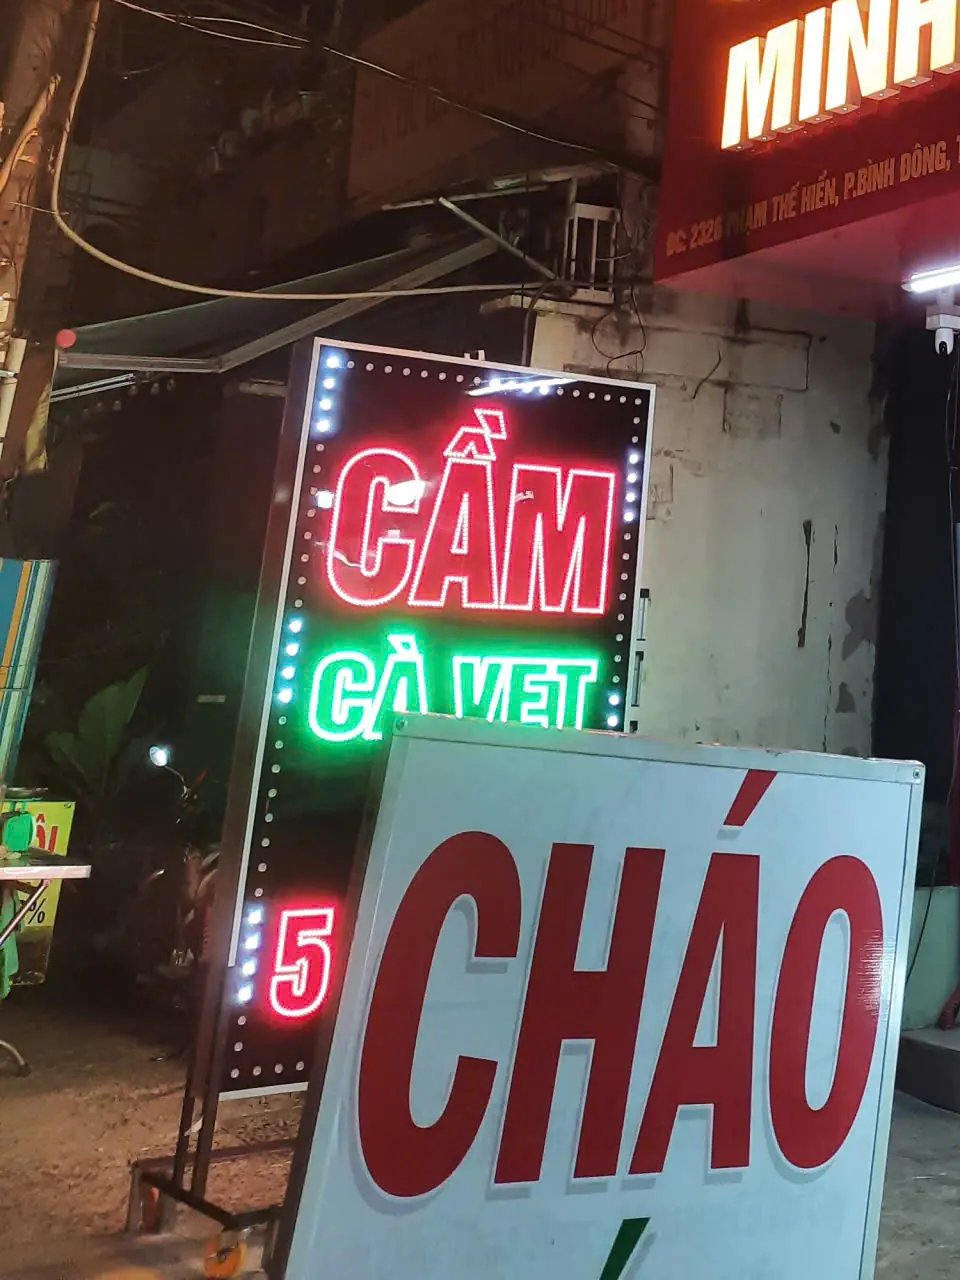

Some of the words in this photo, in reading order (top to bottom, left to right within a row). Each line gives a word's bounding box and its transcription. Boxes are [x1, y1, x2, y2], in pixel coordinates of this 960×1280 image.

[844, 157, 894, 200] P.BÌNH
[899, 140, 951, 183] ĐÔNG,
[326, 408, 616, 614] CẦM
[308, 633, 429, 741] CÀ
[268, 906, 336, 1018] 5
[358, 769, 885, 1198] CHÁO
